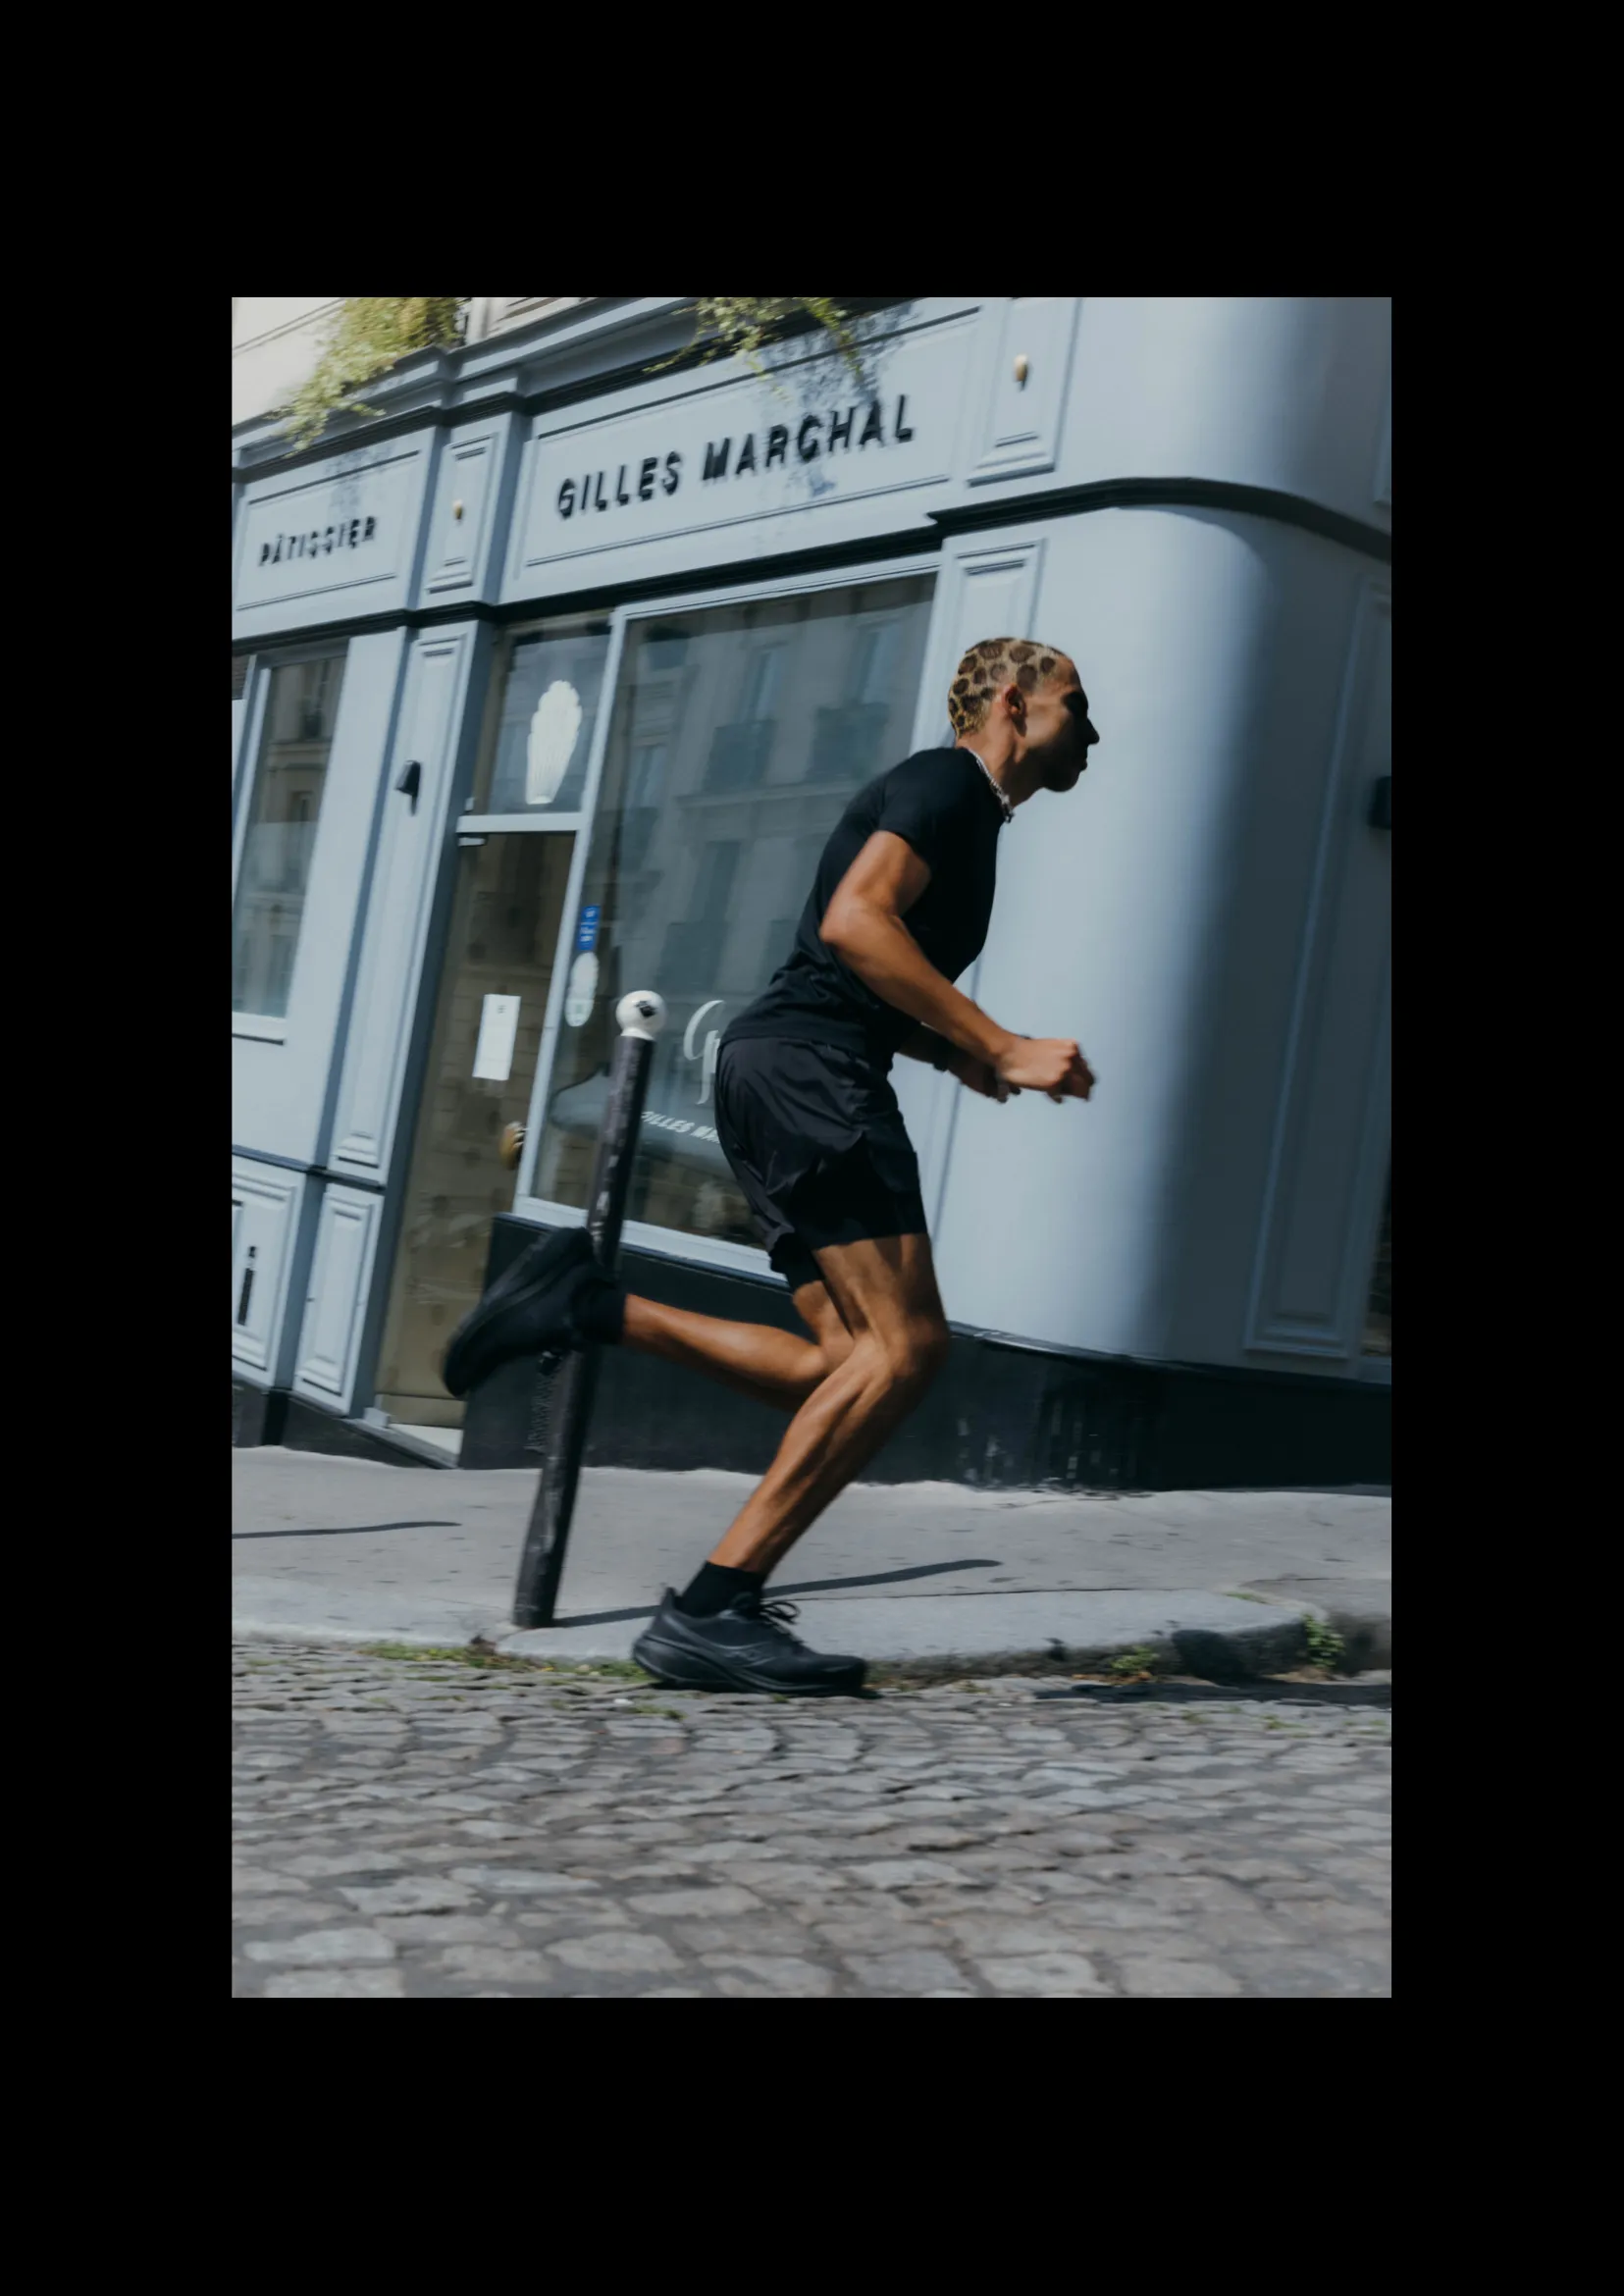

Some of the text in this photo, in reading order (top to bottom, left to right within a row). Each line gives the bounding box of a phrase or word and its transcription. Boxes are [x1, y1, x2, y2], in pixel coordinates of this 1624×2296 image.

[557, 394, 915, 519] GILLES MARCHAL
[258, 515, 377, 566] PÂTISSIER
